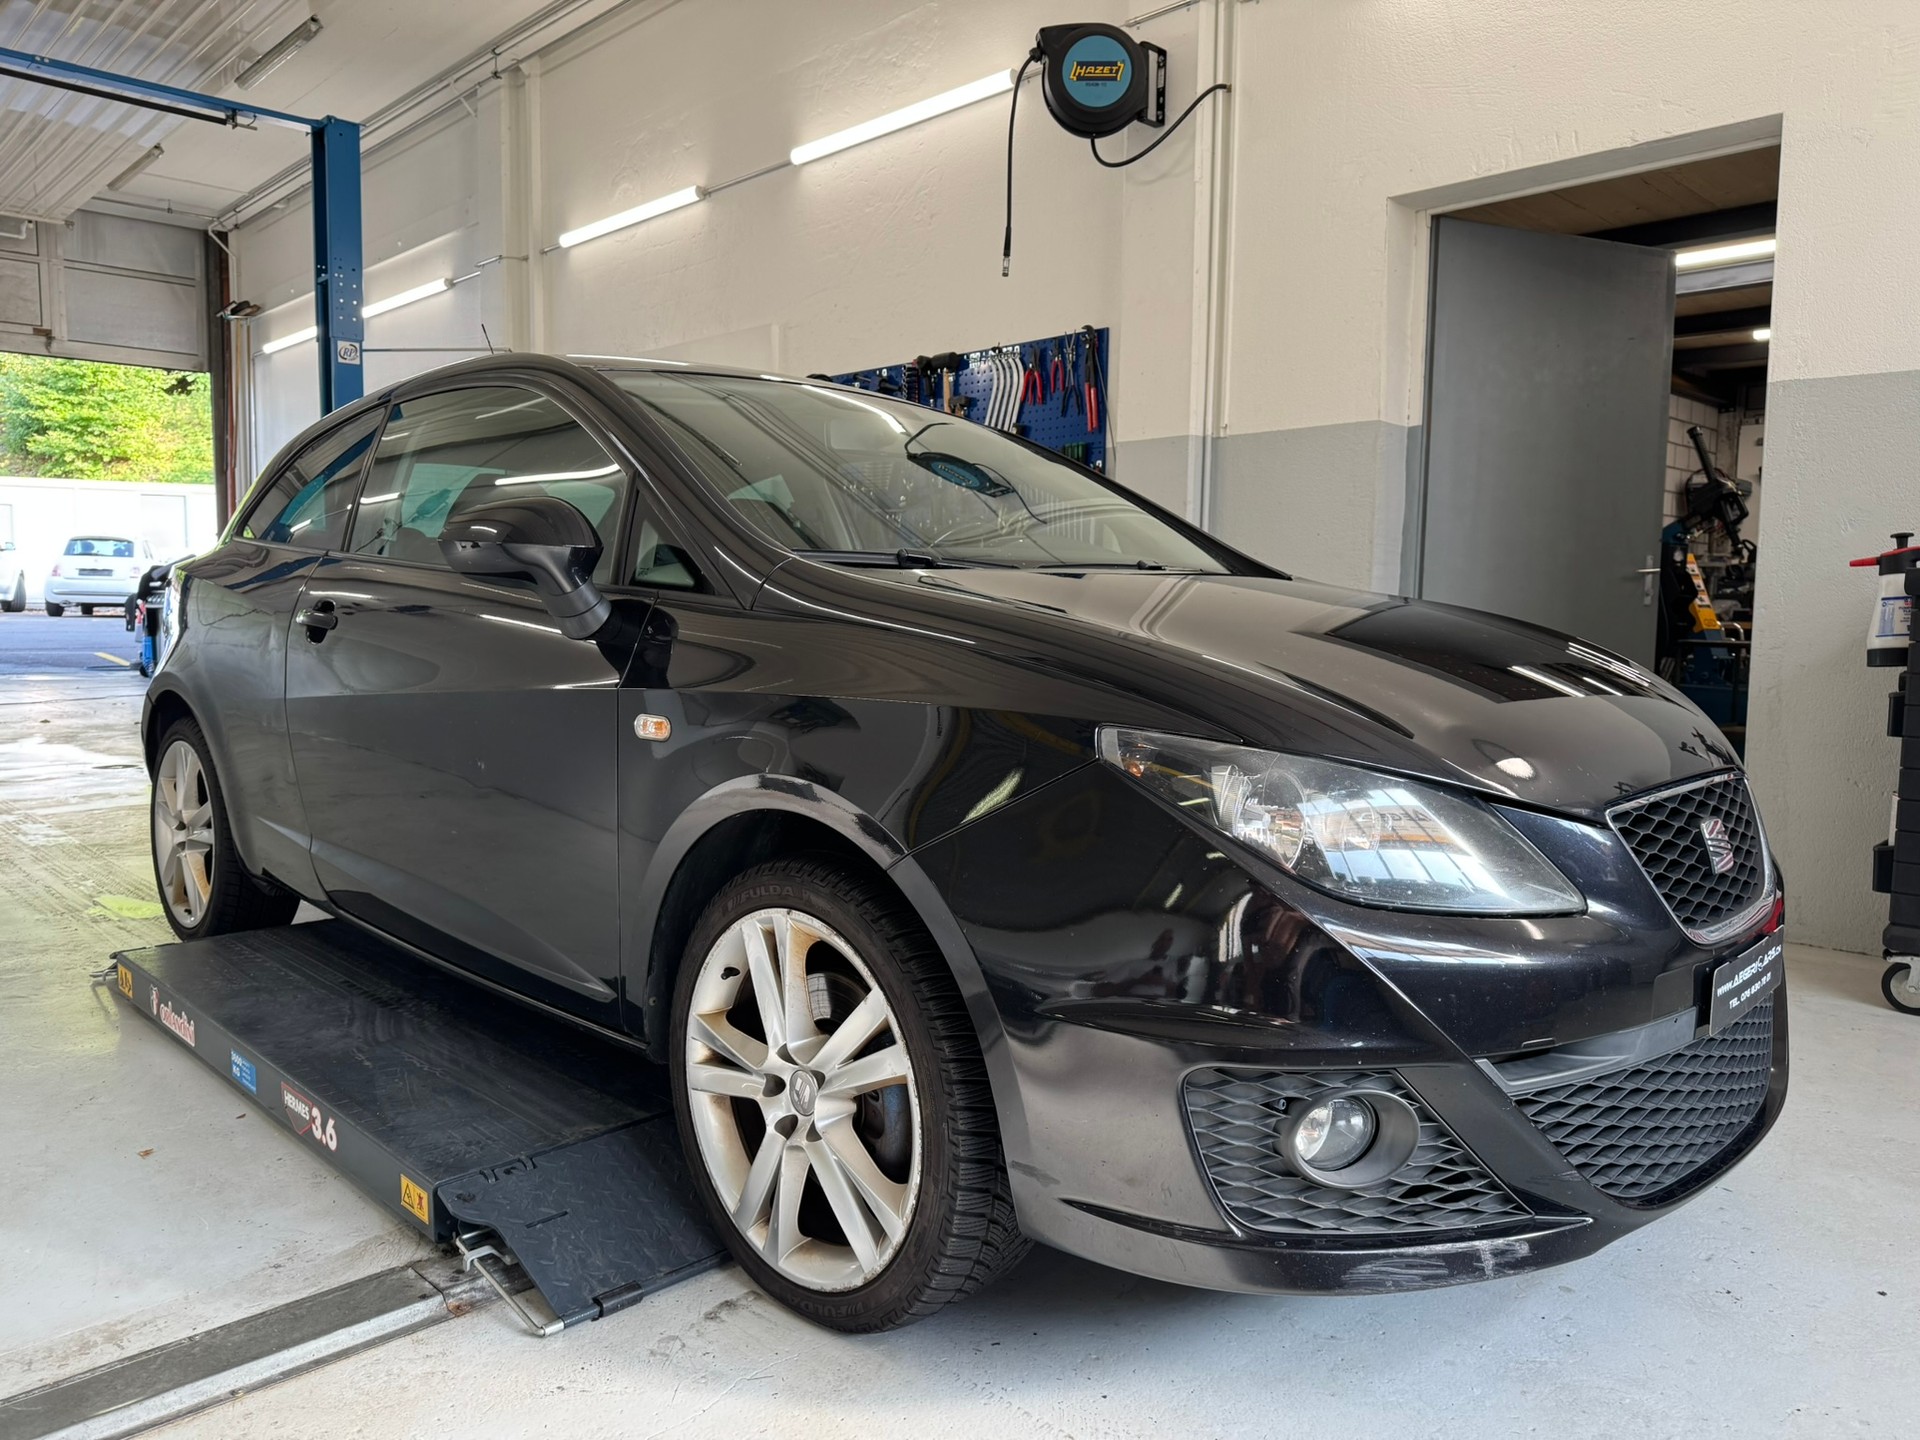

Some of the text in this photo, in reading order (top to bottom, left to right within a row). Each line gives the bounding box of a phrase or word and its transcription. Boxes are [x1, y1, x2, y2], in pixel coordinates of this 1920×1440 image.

[1073, 64, 1121, 78] HAZET
[740, 885, 794, 900] FULDA
[1729, 997, 1740, 1009] TEL.
[284, 1090, 338, 1151] HERMES 3.6
